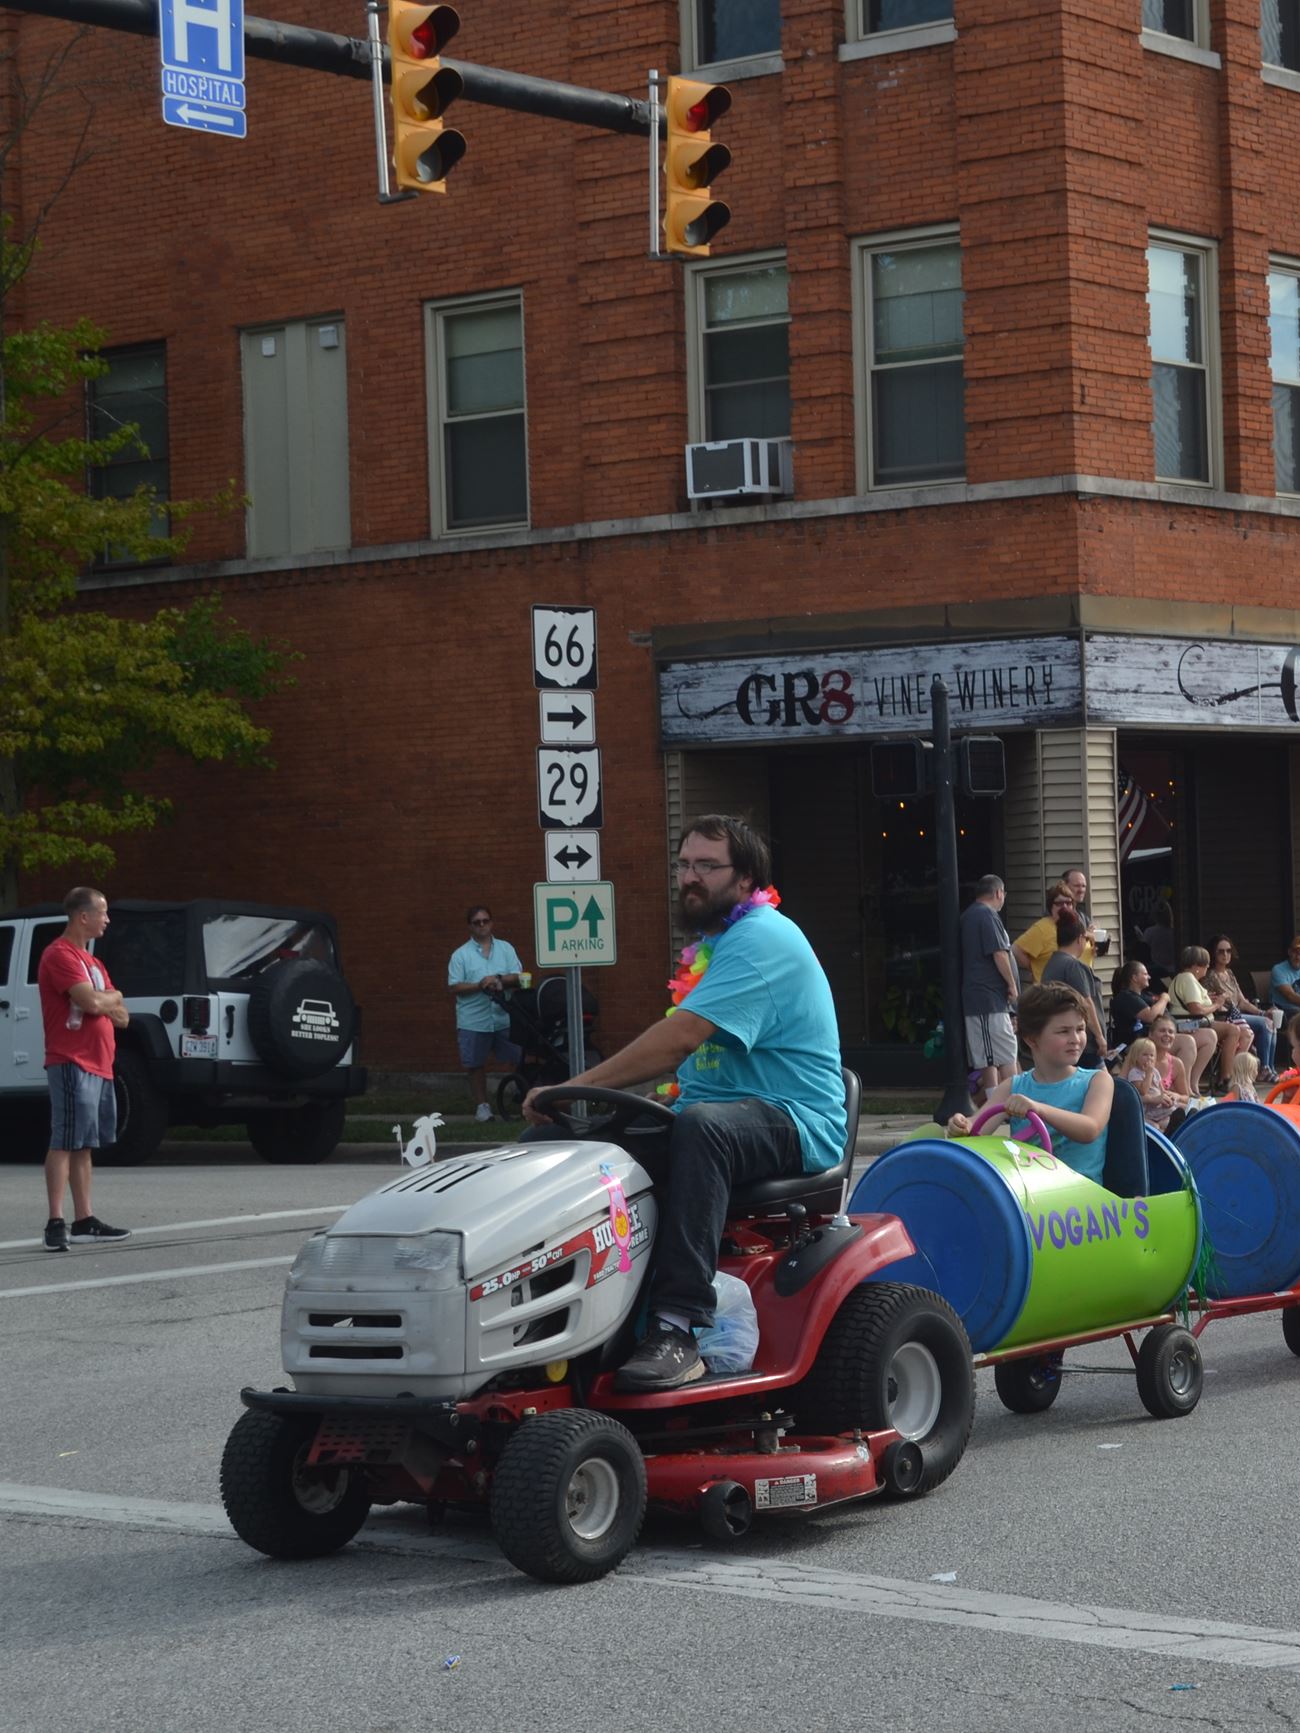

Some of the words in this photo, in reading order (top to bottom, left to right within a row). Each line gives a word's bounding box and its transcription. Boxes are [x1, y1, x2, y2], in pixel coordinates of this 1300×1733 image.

[172, 0, 232, 72] H
[166, 71, 241, 106] HOSPITAL
[545, 624, 585, 667] 66
[735, 669, 855, 727] GR8
[873, 672, 942, 717] VINE
[955, 662, 1054, 713] WINERY
[547, 762, 589, 807] 29
[291, 1030, 313, 1038] BETTER
[301, 1023, 312, 1031] SHE
[592, 1204, 642, 1253] HUE
[1026, 1200, 1151, 1251] VOGAN'S
